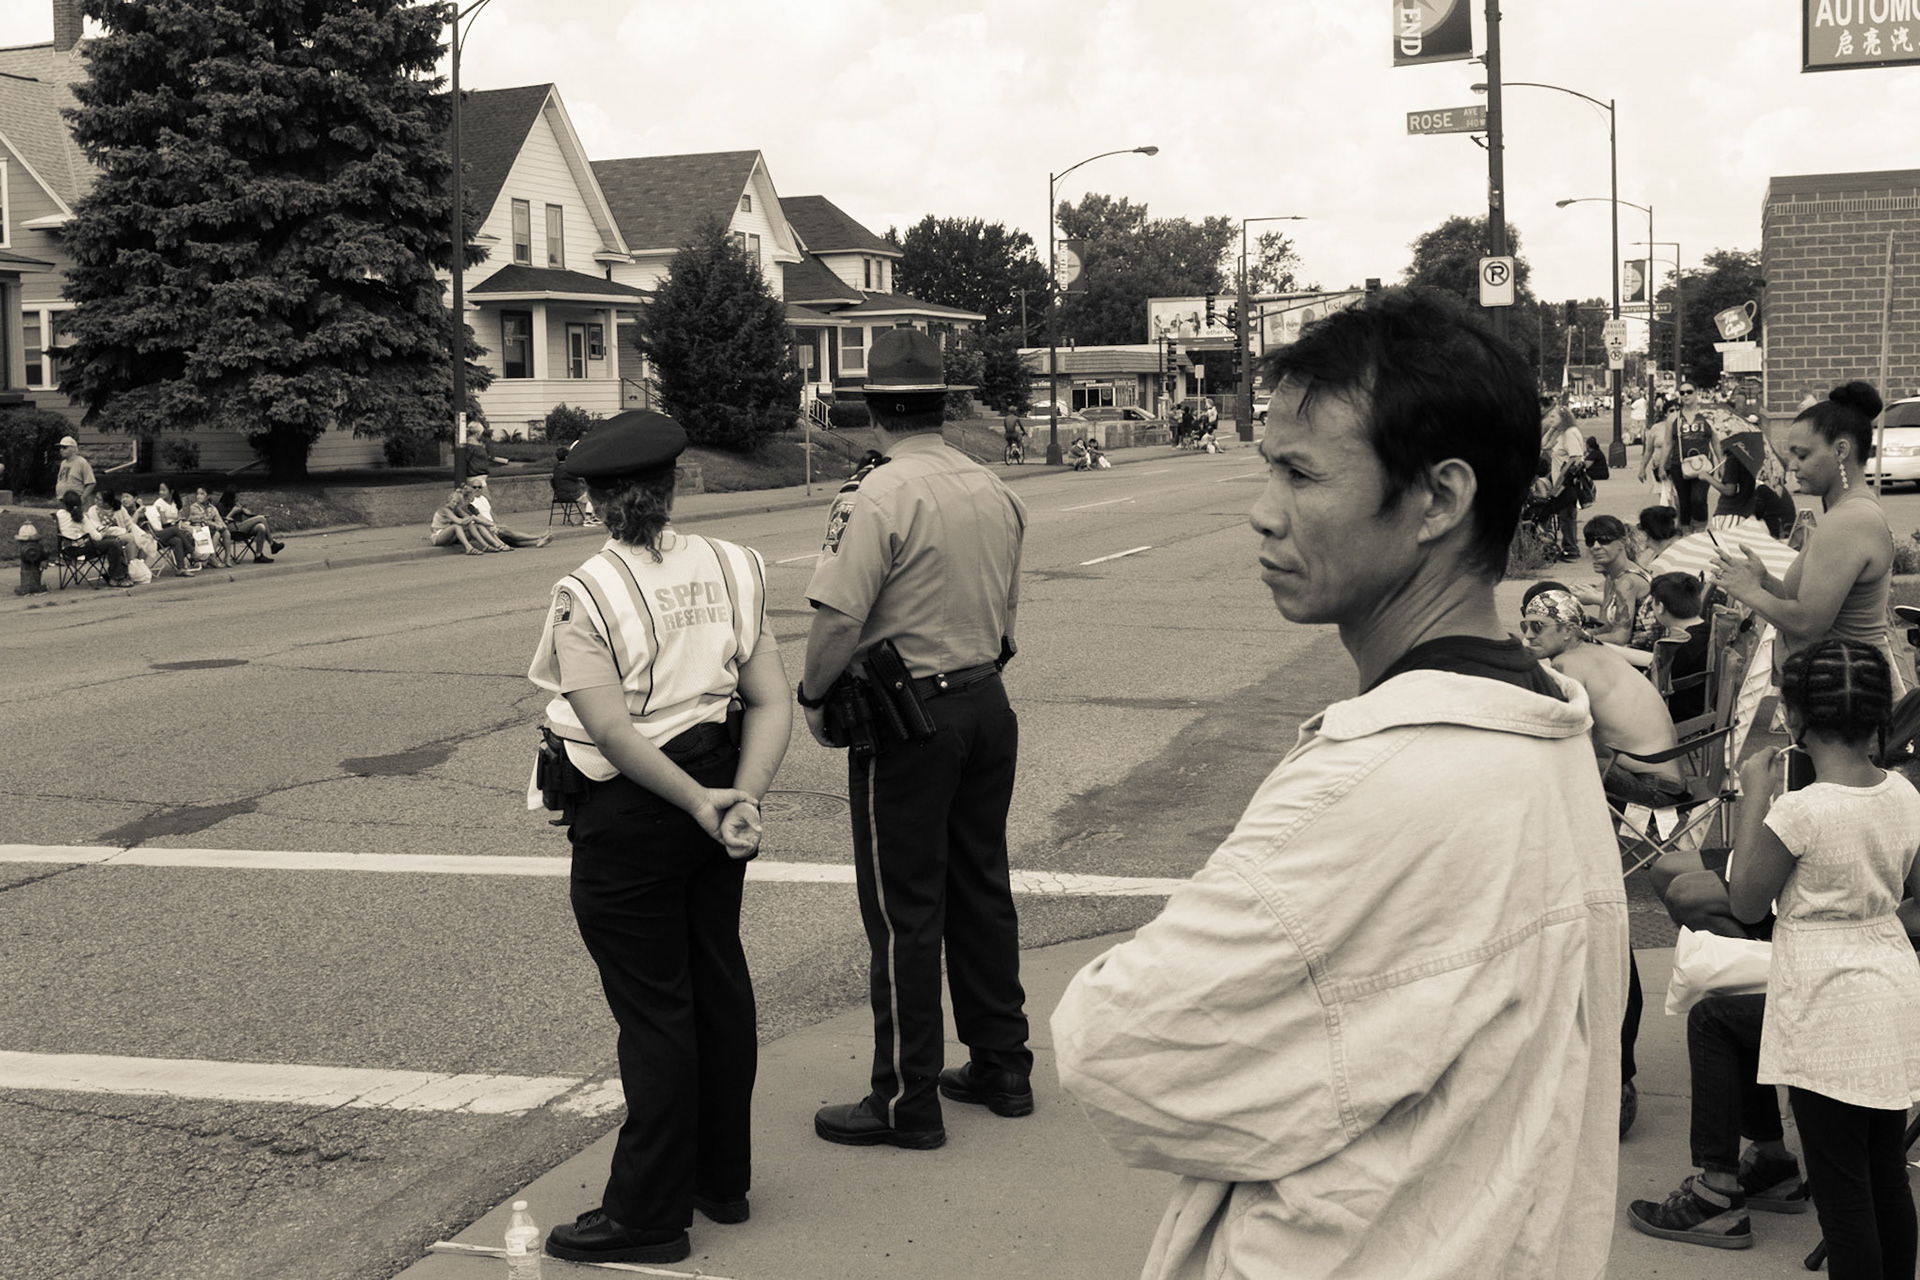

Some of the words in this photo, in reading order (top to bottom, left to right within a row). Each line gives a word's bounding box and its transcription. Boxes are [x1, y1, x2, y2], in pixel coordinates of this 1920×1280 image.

[1834, 26, 1920, 58] 启亮汽
[1409, 112, 1453, 131] ROSE
[1463, 107, 1479, 117] AVE
[654, 581, 722, 612] SPPD
